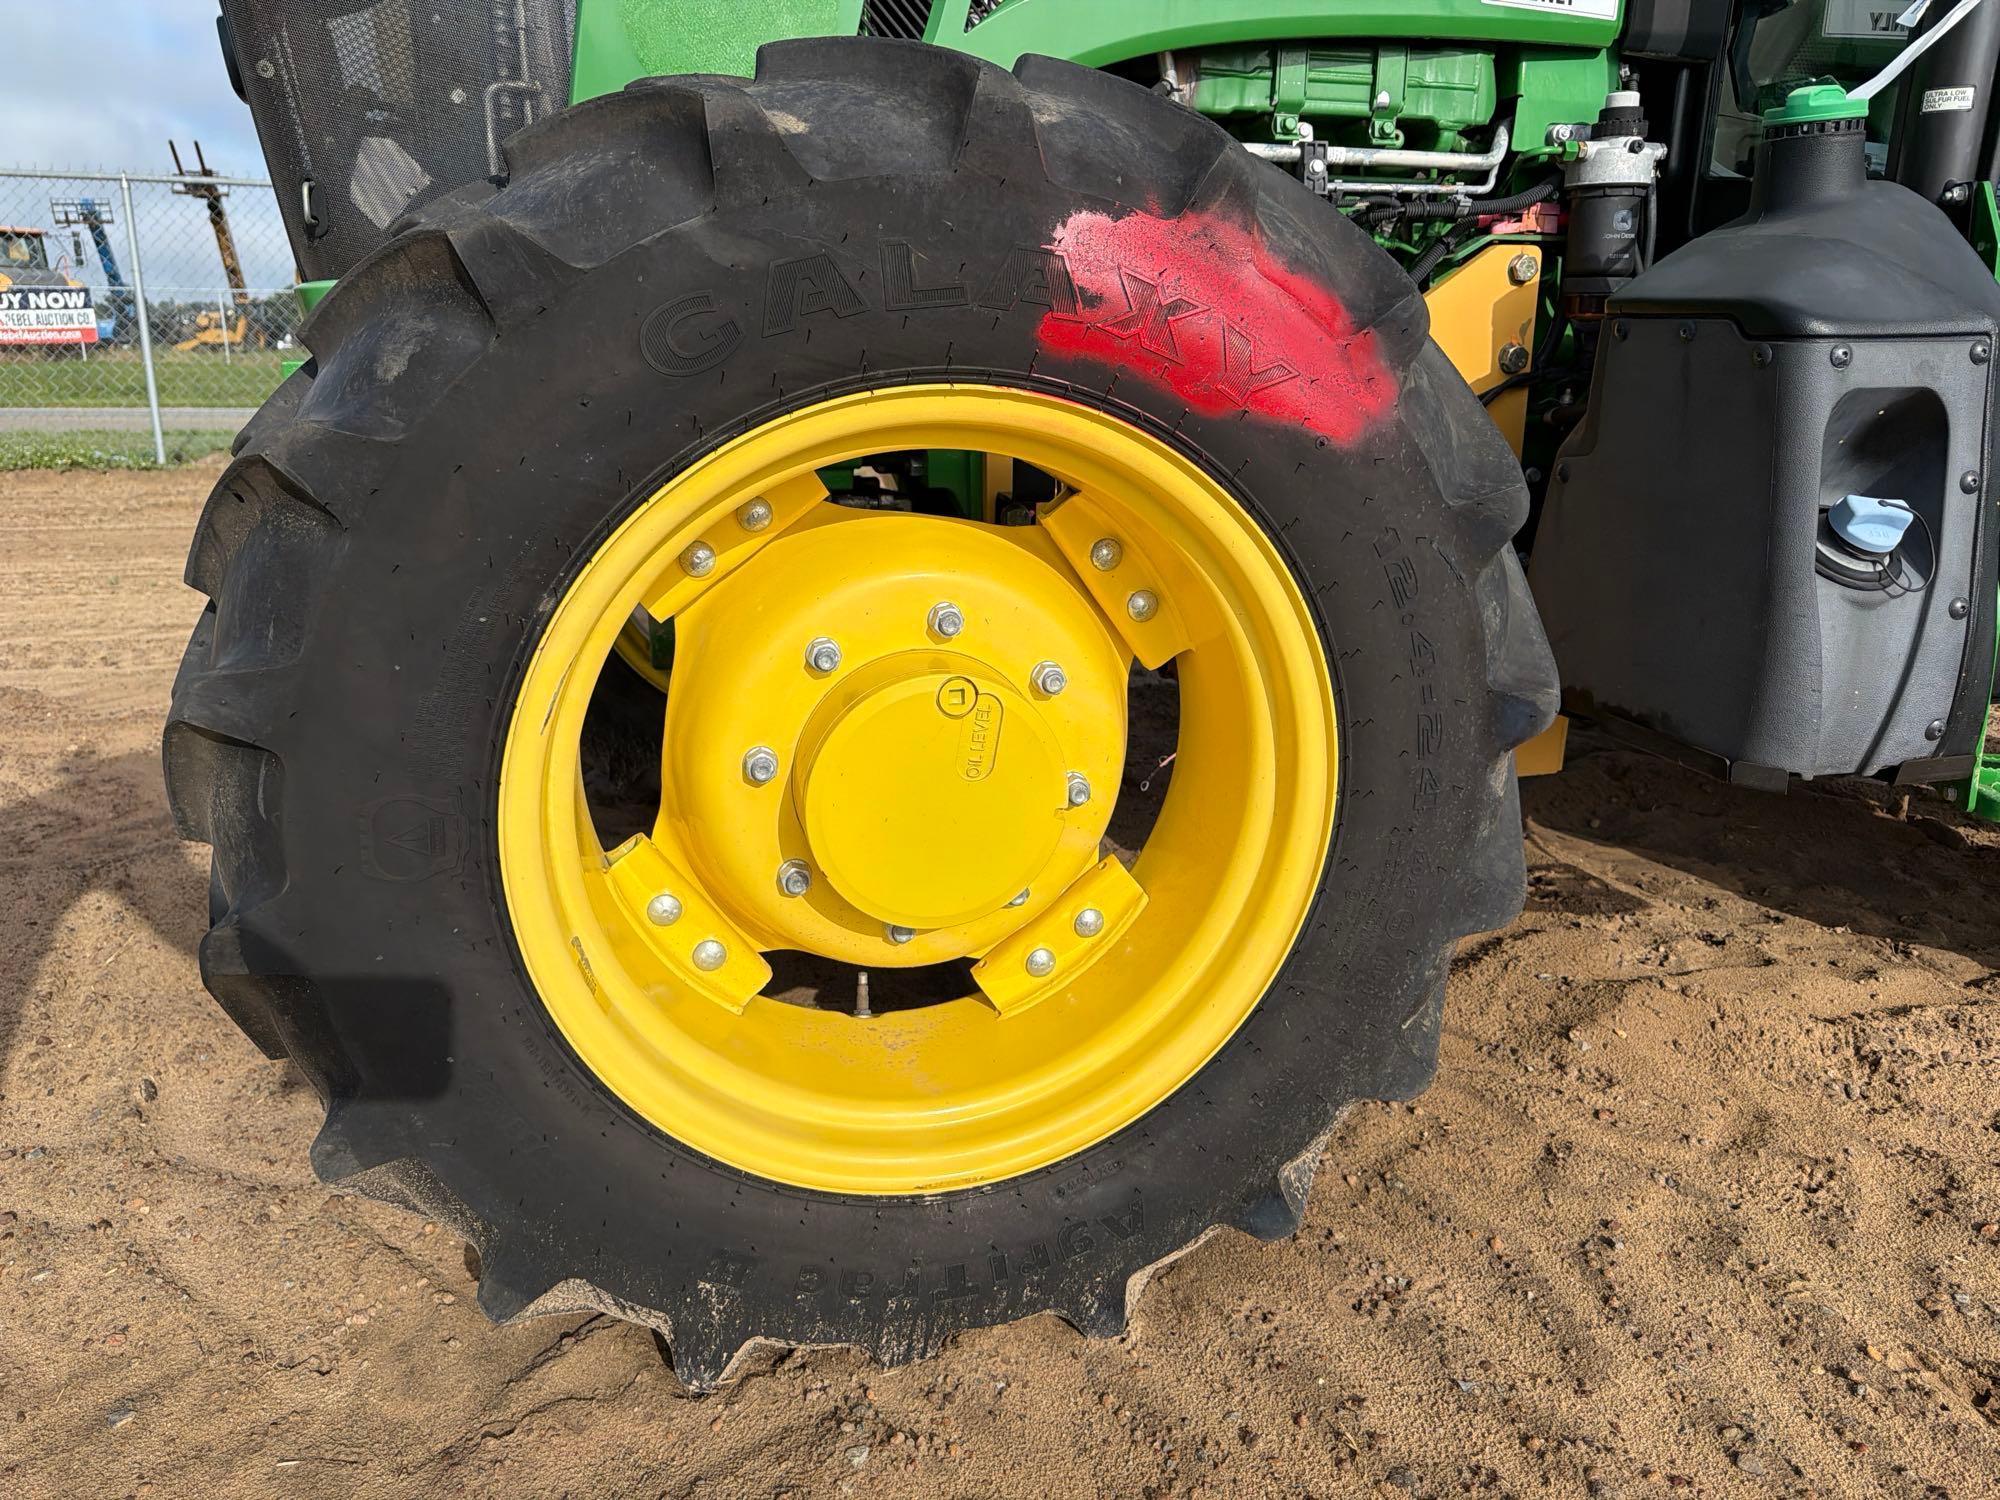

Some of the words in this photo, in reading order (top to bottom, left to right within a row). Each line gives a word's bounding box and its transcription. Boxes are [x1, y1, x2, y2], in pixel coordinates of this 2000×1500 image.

[1925, 91, 1948, 99] ULTRA
[0, 292, 22, 309] UY
[28, 291, 86, 309] NOW
[36, 312, 75, 326] AUCTION
[640, 237, 1300, 407] GALAXY
[1372, 526, 1442, 813] 12.4-24
[969, 704, 992, 752] LEVEL
[965, 754, 983, 778] OIL
